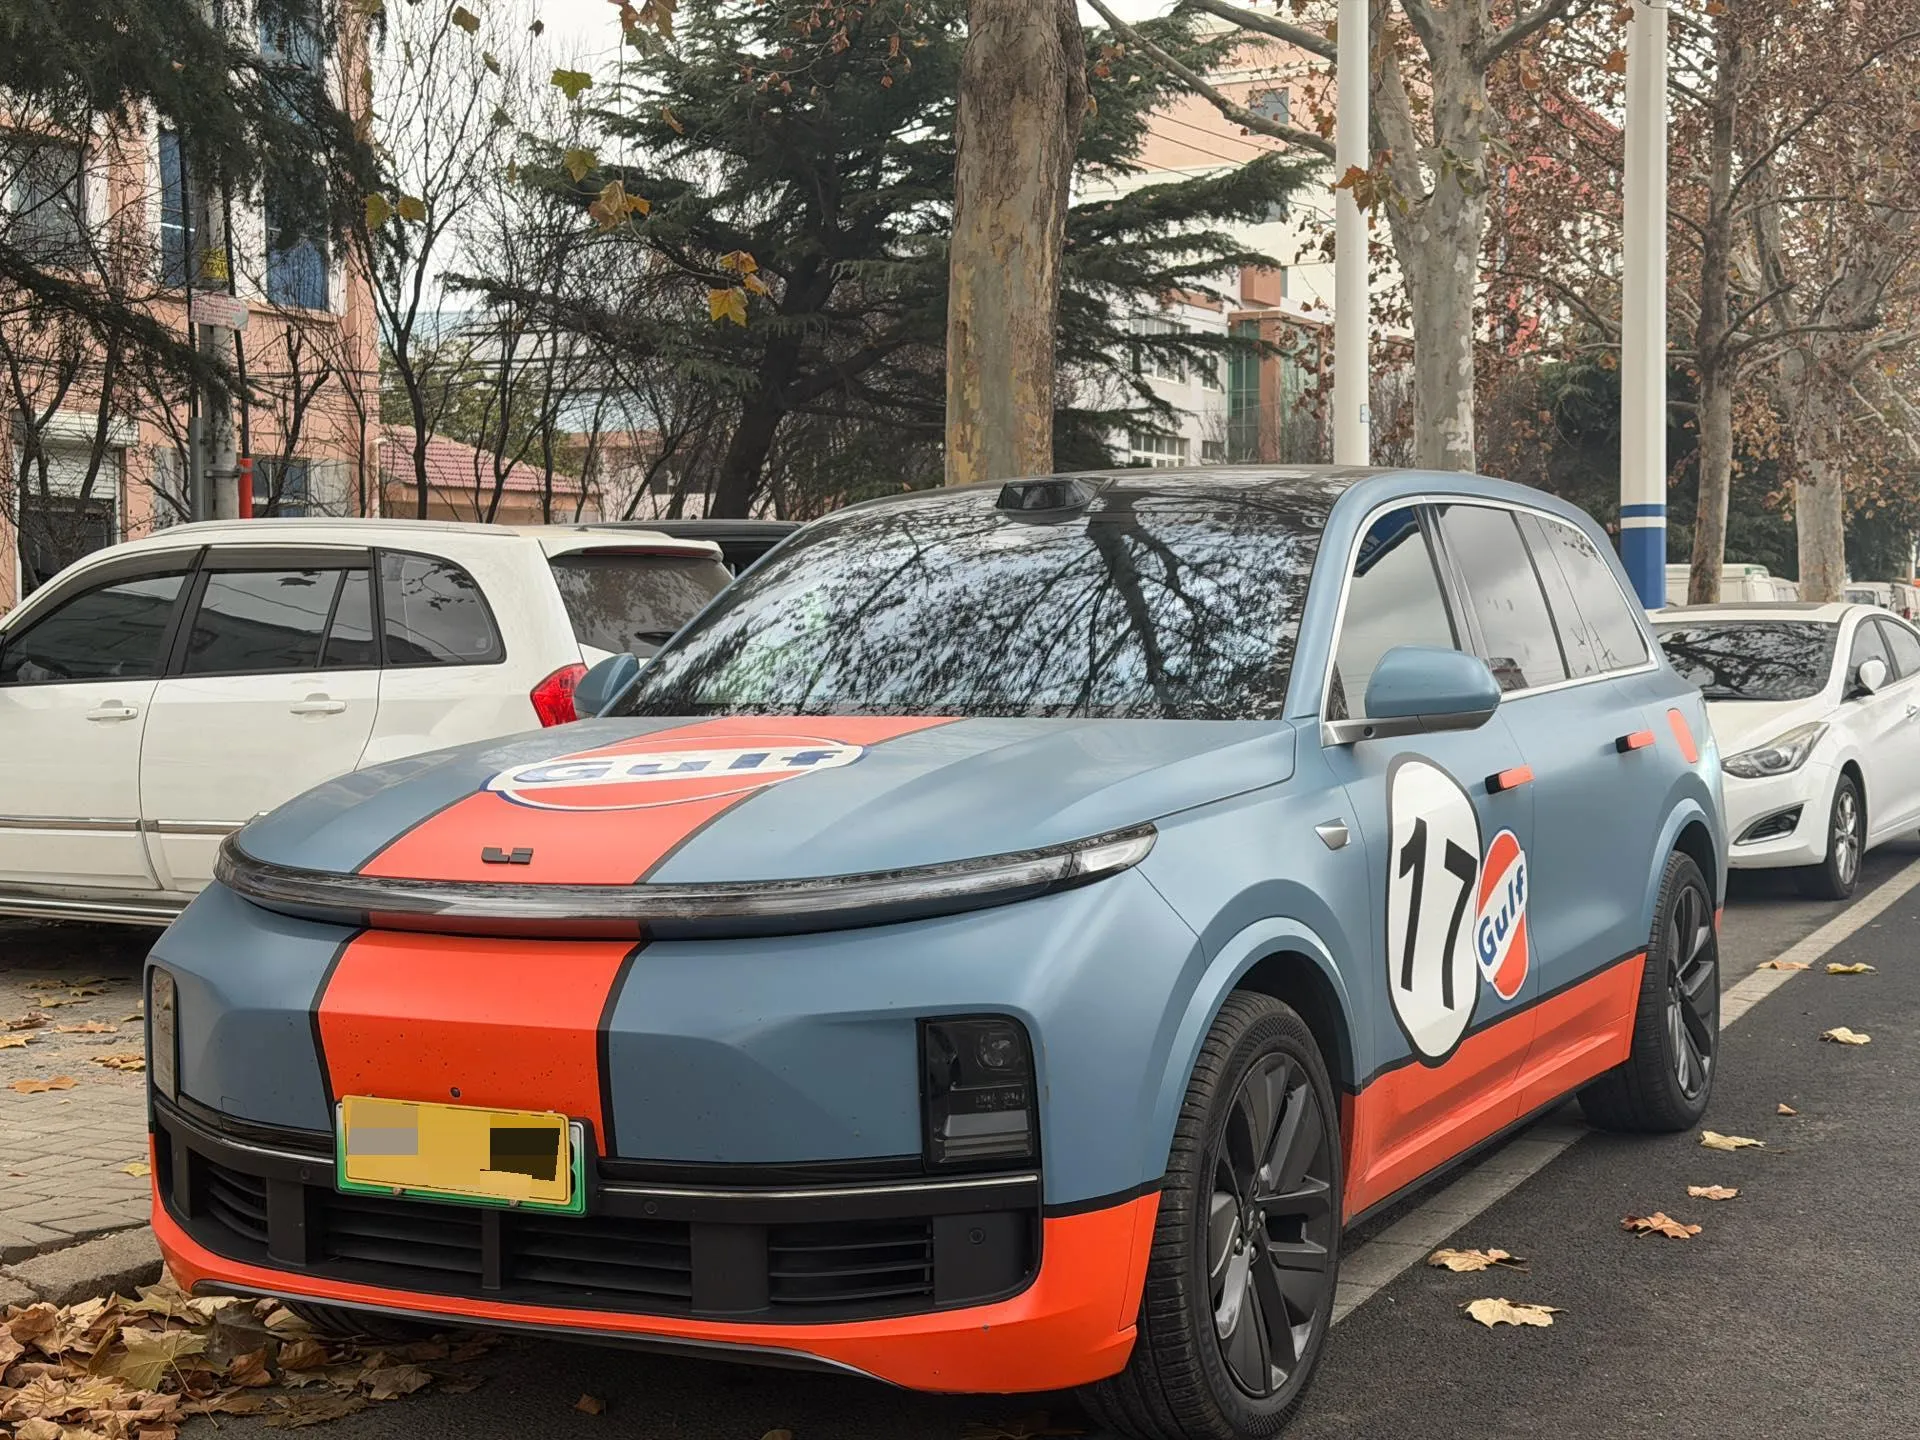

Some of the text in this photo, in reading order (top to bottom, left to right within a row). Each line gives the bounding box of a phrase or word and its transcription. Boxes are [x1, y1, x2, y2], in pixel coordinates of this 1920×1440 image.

[512, 750, 844, 782] Gulf
[1399, 816, 1478, 1011] 17
[1478, 864, 1524, 967] Gulf
